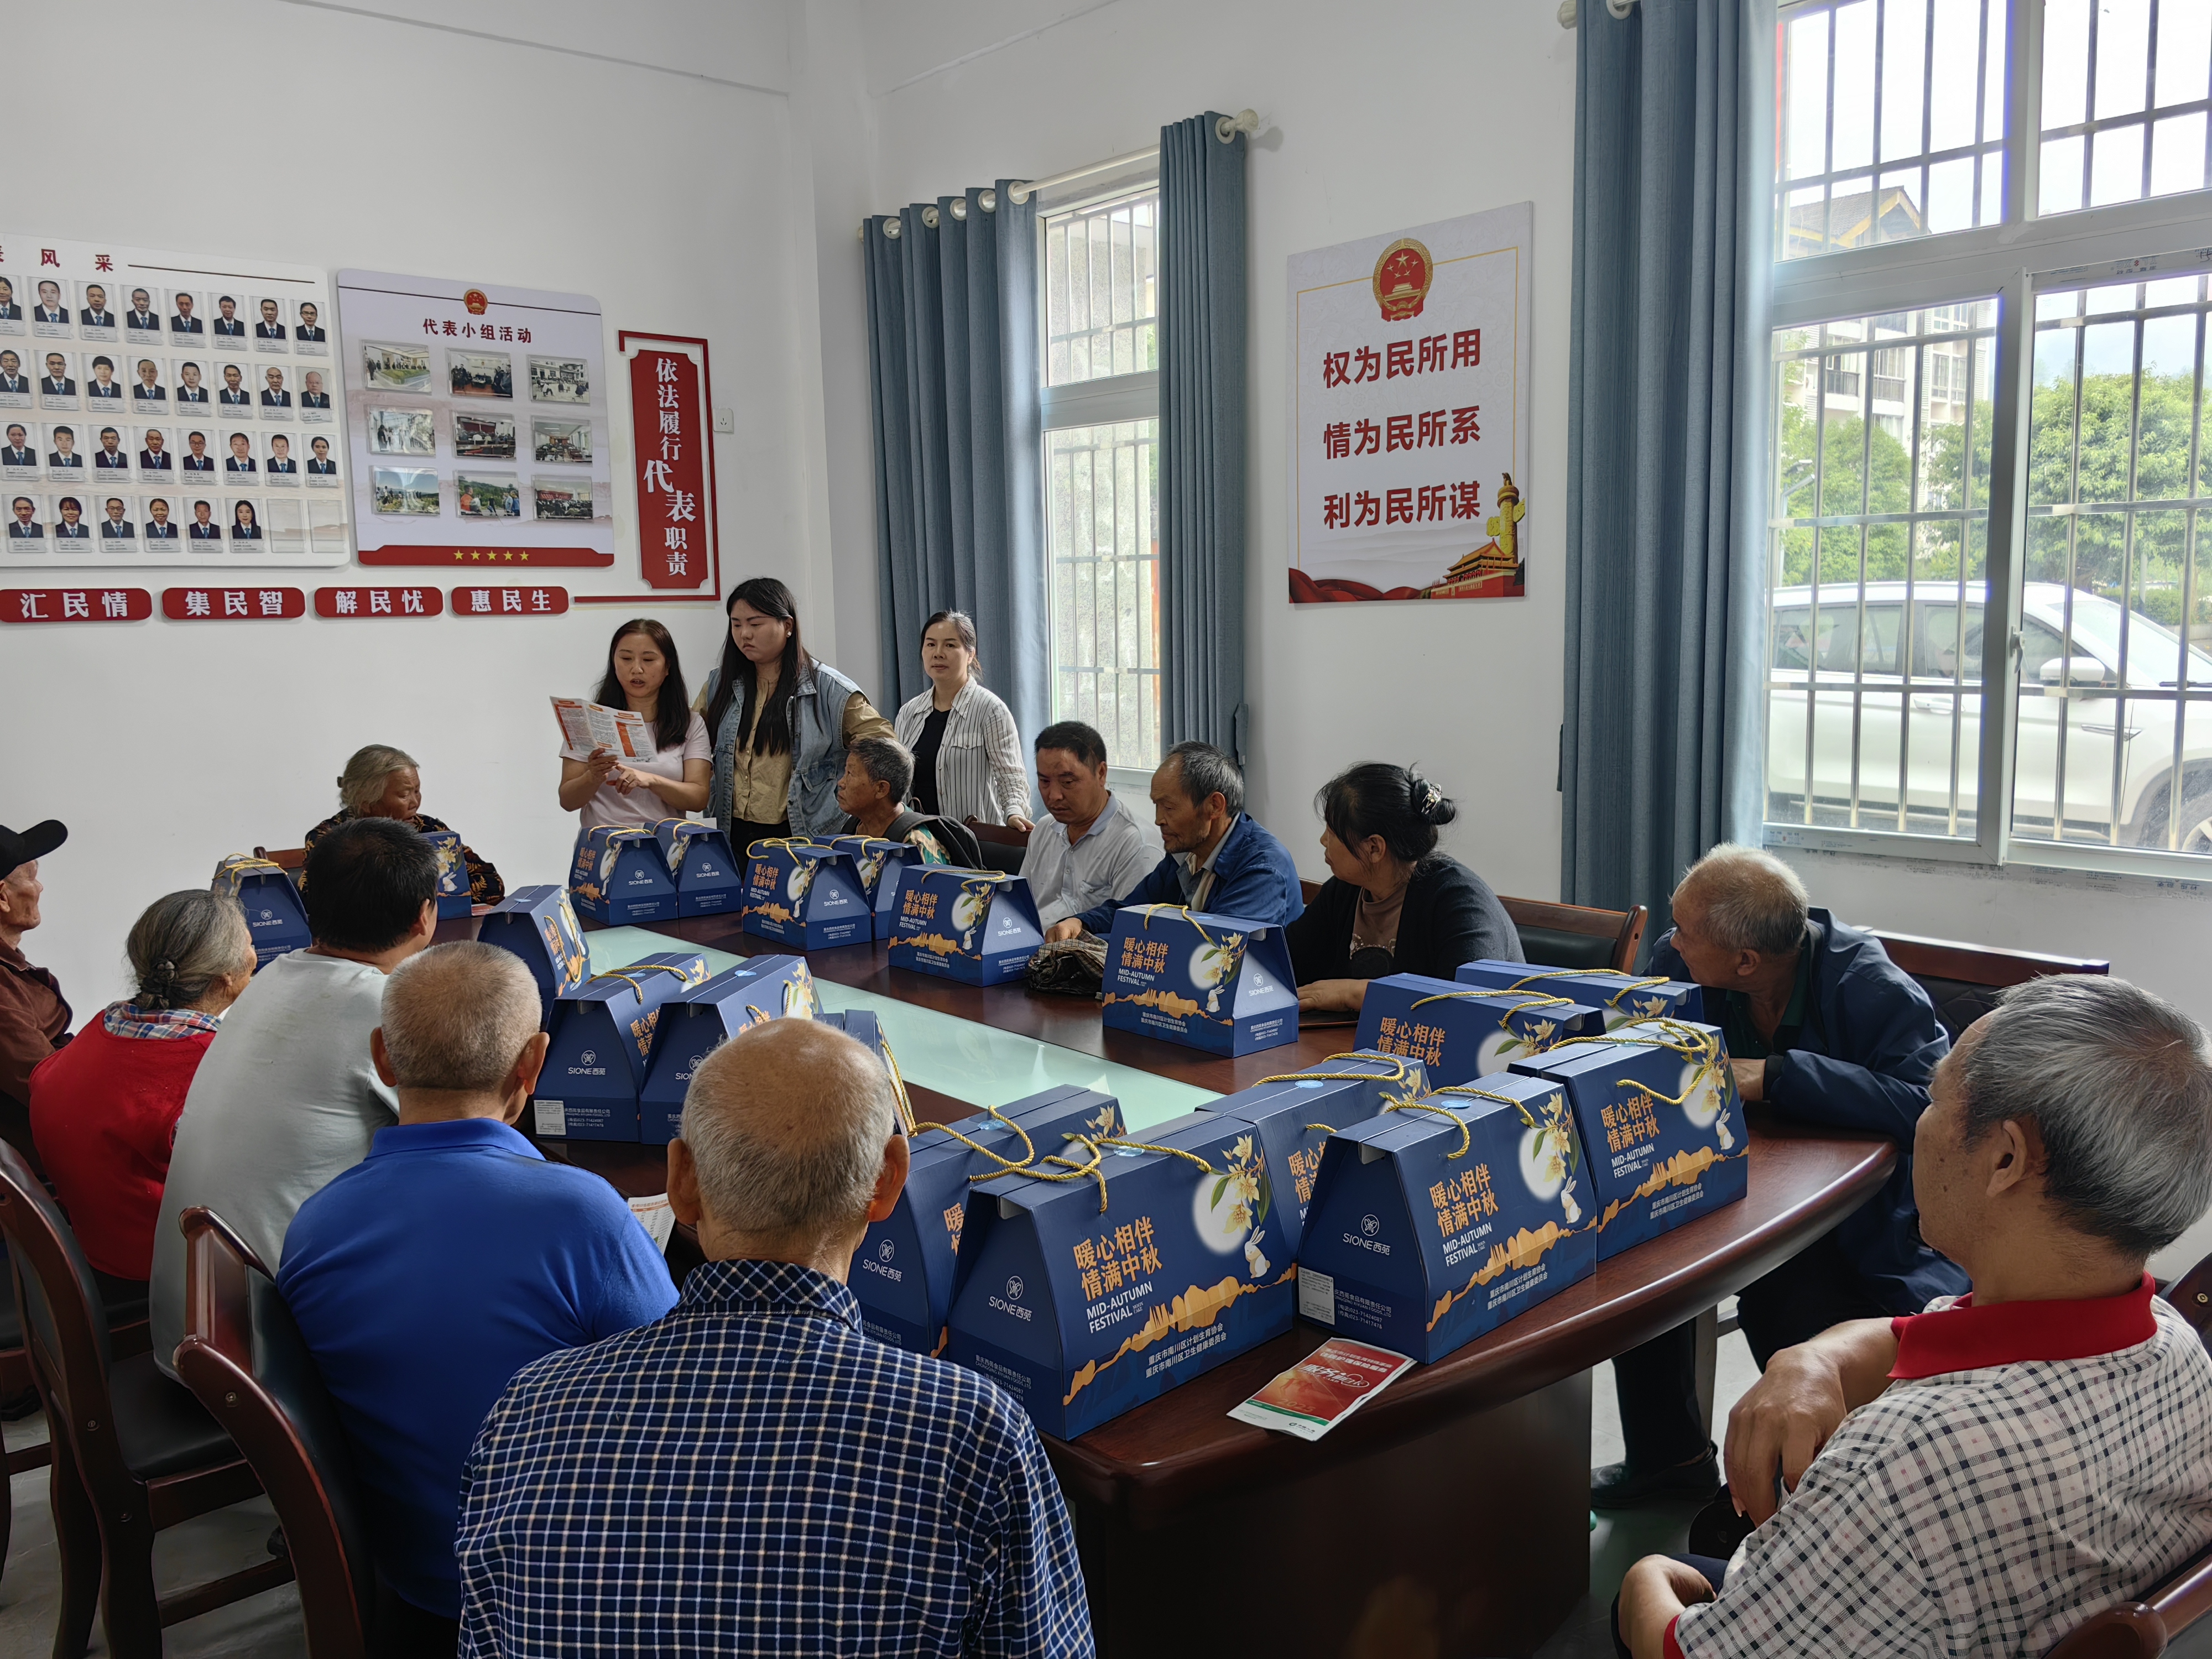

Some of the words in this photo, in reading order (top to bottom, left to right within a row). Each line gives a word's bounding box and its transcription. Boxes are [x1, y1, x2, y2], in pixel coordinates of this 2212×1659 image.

[423, 319, 532, 343] 代表小组活动
[1323, 328, 1480, 388] 权为民所用
[1323, 405, 1480, 460] 情为民所系
[1323, 481, 1480, 529] 利为民所谋
[20, 592, 127, 618] 汇民情
[186, 591, 283, 616] 集民智
[335, 589, 425, 614] 解民忧
[471, 589, 551, 612] 惠民生
[753, 874, 776, 890] 情满中秋
[754, 864, 779, 878] 暖心相伴
[903, 902, 935, 919] 情满中秋
[905, 890, 938, 906] 暖心相伴
[899, 922, 916, 931] FESTIVAL
[900, 916, 927, 926] MID-AUTUMN
[1124, 937, 1168, 958] 暖心相伴
[1121, 951, 1165, 973] 情满中秋
[1118, 968, 1155, 982] MID-AUTUMN
[1118, 975, 1140, 986] FESTIVAL
[630, 1007, 660, 1037] 暖心相
[1380, 1017, 1446, 1047] 暖心相伴
[1377, 1035, 1442, 1067] 情满中秋
[1601, 1092, 1653, 1128] 暖心相伴
[1607, 1114, 1660, 1153] 情满中秋
[1611, 1143, 1655, 1167] MID-AUTUMN
[1614, 1160, 1642, 1178] FESTIVAL
[1430, 1163, 1491, 1208] 暖心相伴
[1437, 1188, 1499, 1238] 情满中秋
[1073, 1216, 1155, 1270] 暖心相伴
[1443, 1222, 1492, 1254] MID-AUTUMN
[1446, 1243, 1478, 1266] FESTIVAL
[1081, 1244, 1162, 1301] 情满中秋
[1087, 1281, 1153, 1319] MID-AUTUMN
[1334, 1289, 1391, 1313] 庆西苑食品有限责任公司
[1089, 1307, 1133, 1334] FESTIVAL
[1146, 1332, 1227, 1378] 重庆市南川区卫生健康委员会
[1149, 1323, 1223, 1365] 重庆市南川区计划生育协会
[1276, 1399, 1316, 1412] 2025
